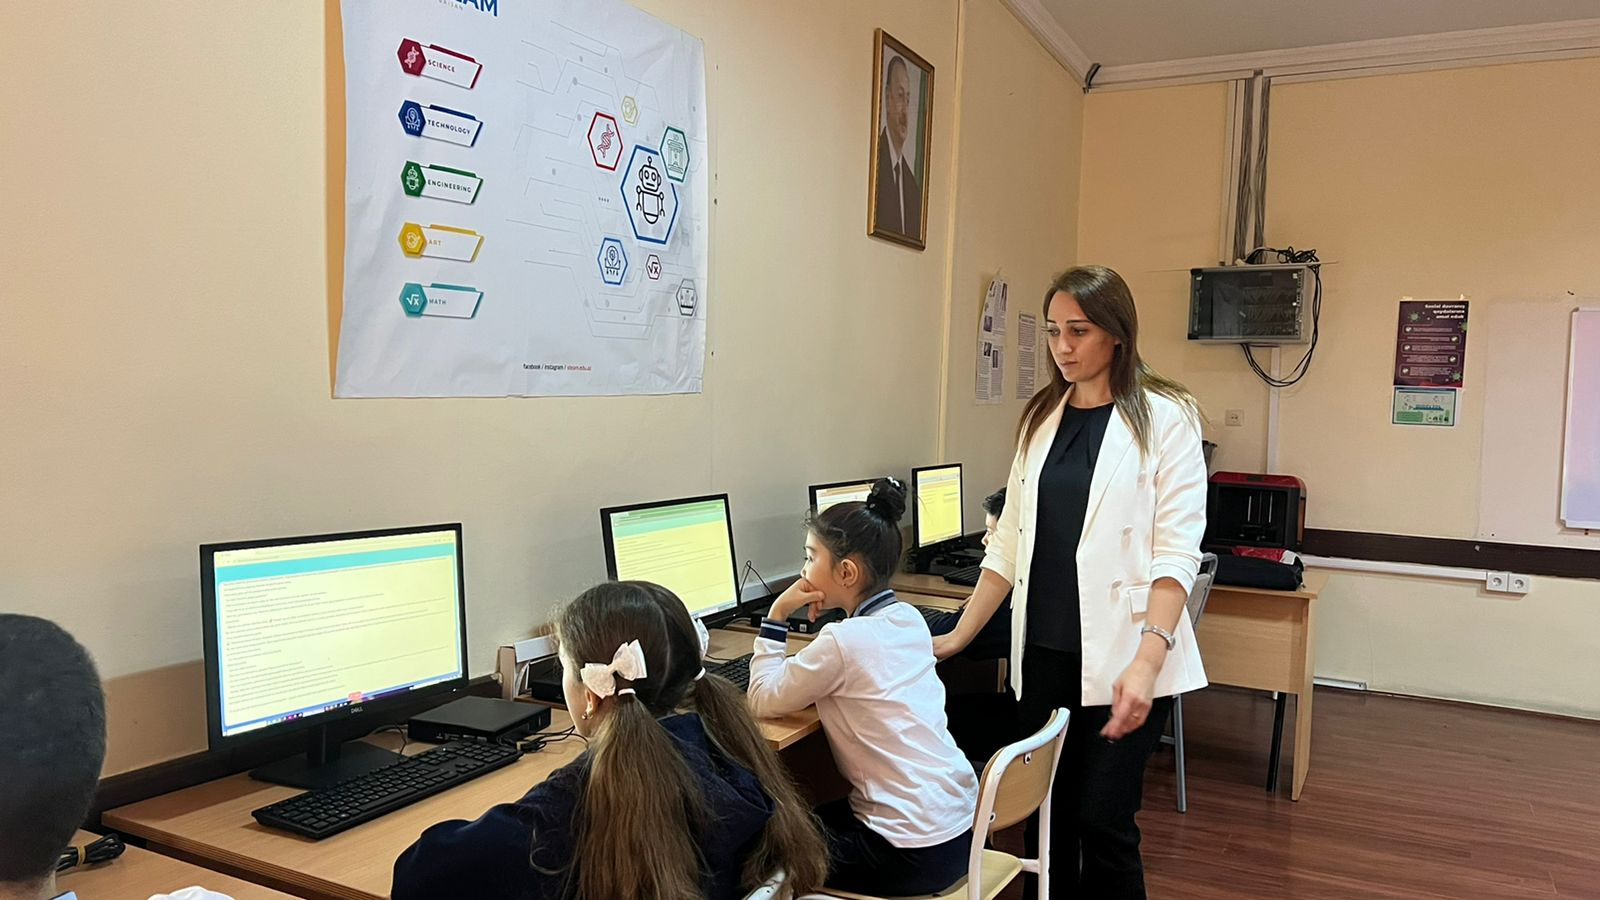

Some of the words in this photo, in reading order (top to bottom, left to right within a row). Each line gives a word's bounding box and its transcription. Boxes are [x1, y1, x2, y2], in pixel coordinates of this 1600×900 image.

[428, 59, 456, 73] SCIENCE
[427, 119, 471, 135] TECHNOLOGY
[427, 179, 472, 193] ENGINEERING
